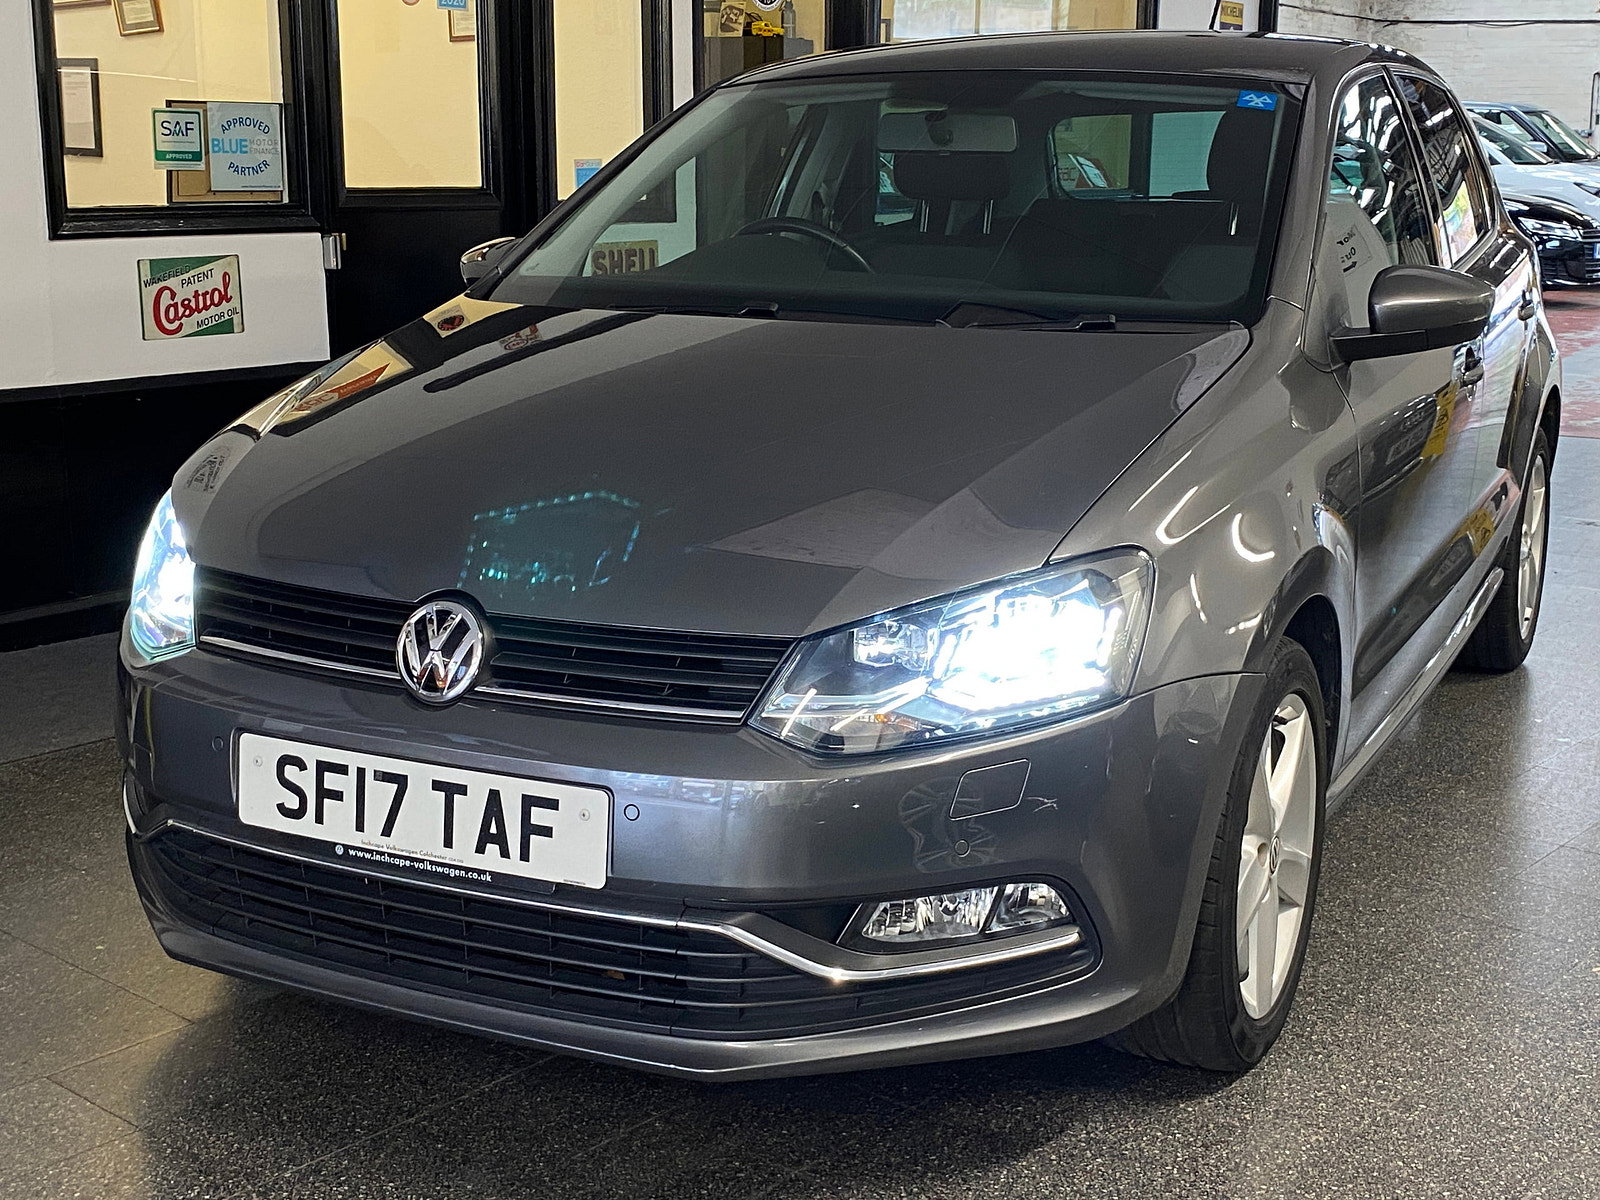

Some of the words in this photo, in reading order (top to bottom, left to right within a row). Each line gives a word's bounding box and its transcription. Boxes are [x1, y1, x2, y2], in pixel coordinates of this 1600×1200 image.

[160, 120, 195, 137] SAF
[220, 116, 271, 135] APPROVED
[211, 138, 248, 154] BLUE
[249, 138, 279, 146] MOTOR
[227, 159, 271, 176] PARTNER
[143, 265, 192, 288] WAKEFIELD
[181, 268, 215, 288] PATENT
[153, 271, 234, 336] Castrol
[196, 312, 226, 329] MOTOR
[226, 306, 240, 319] OIL
[276, 754, 409, 838] SF17
[431, 779, 560, 863] TAF
[348, 848, 492, 882] www.inchcape-volkswagen.co.uk
